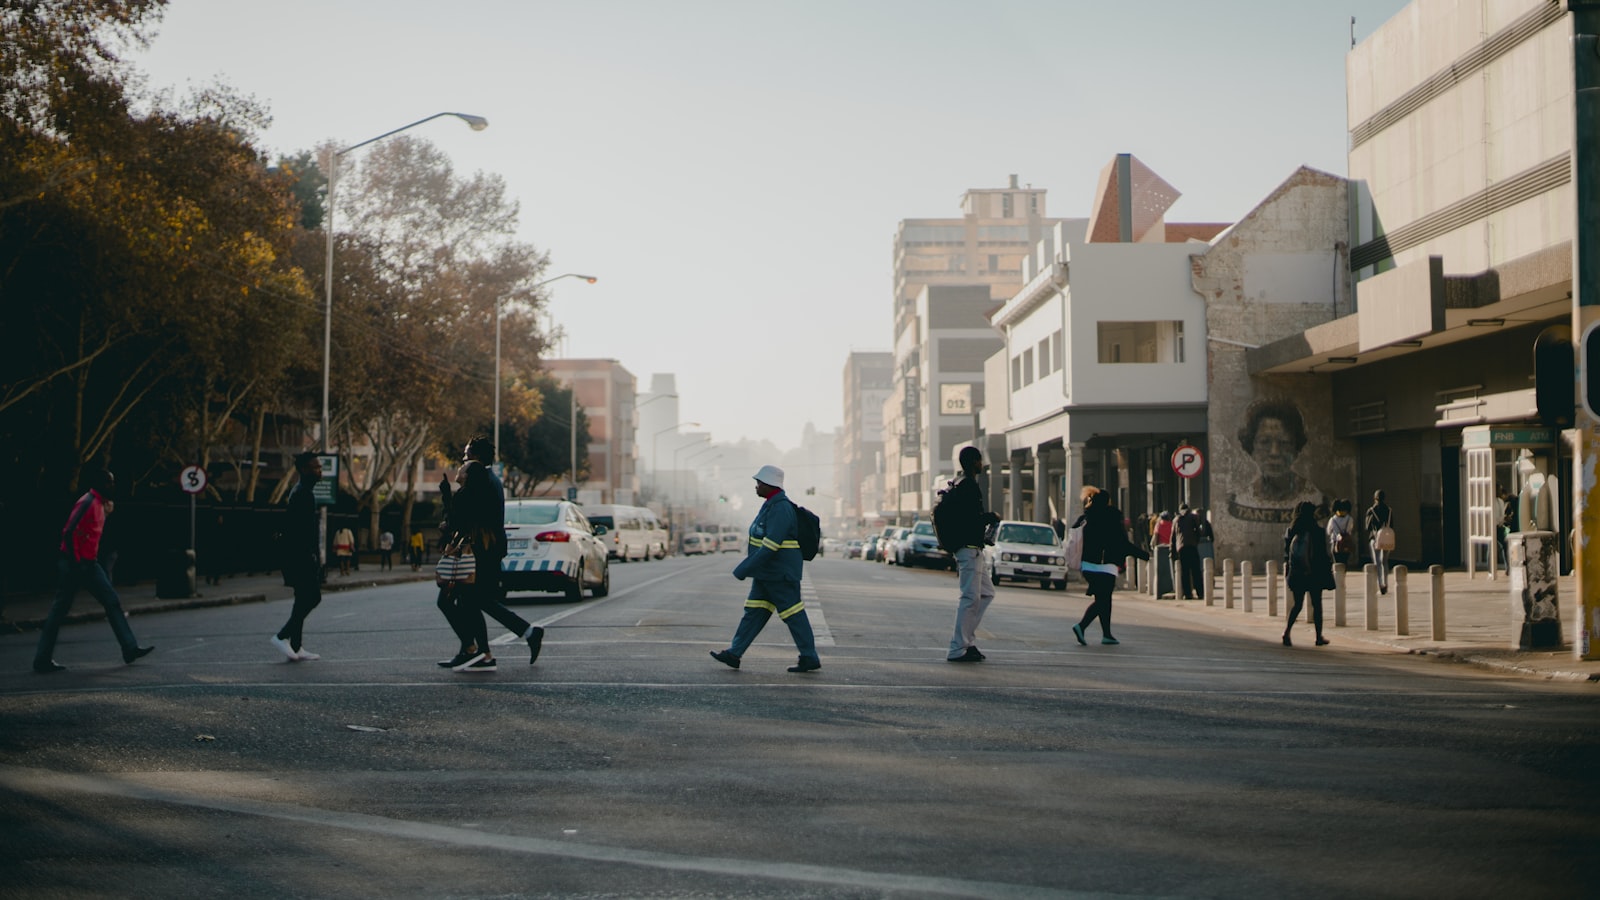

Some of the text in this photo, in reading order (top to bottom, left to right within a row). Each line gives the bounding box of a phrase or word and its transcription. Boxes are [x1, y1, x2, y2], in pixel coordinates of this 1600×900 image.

[947, 399, 966, 409] 012
[1495, 431, 1550, 441] FNB ATM
[1182, 453, 1195, 470] P
[1236, 505, 1275, 520] TANT
